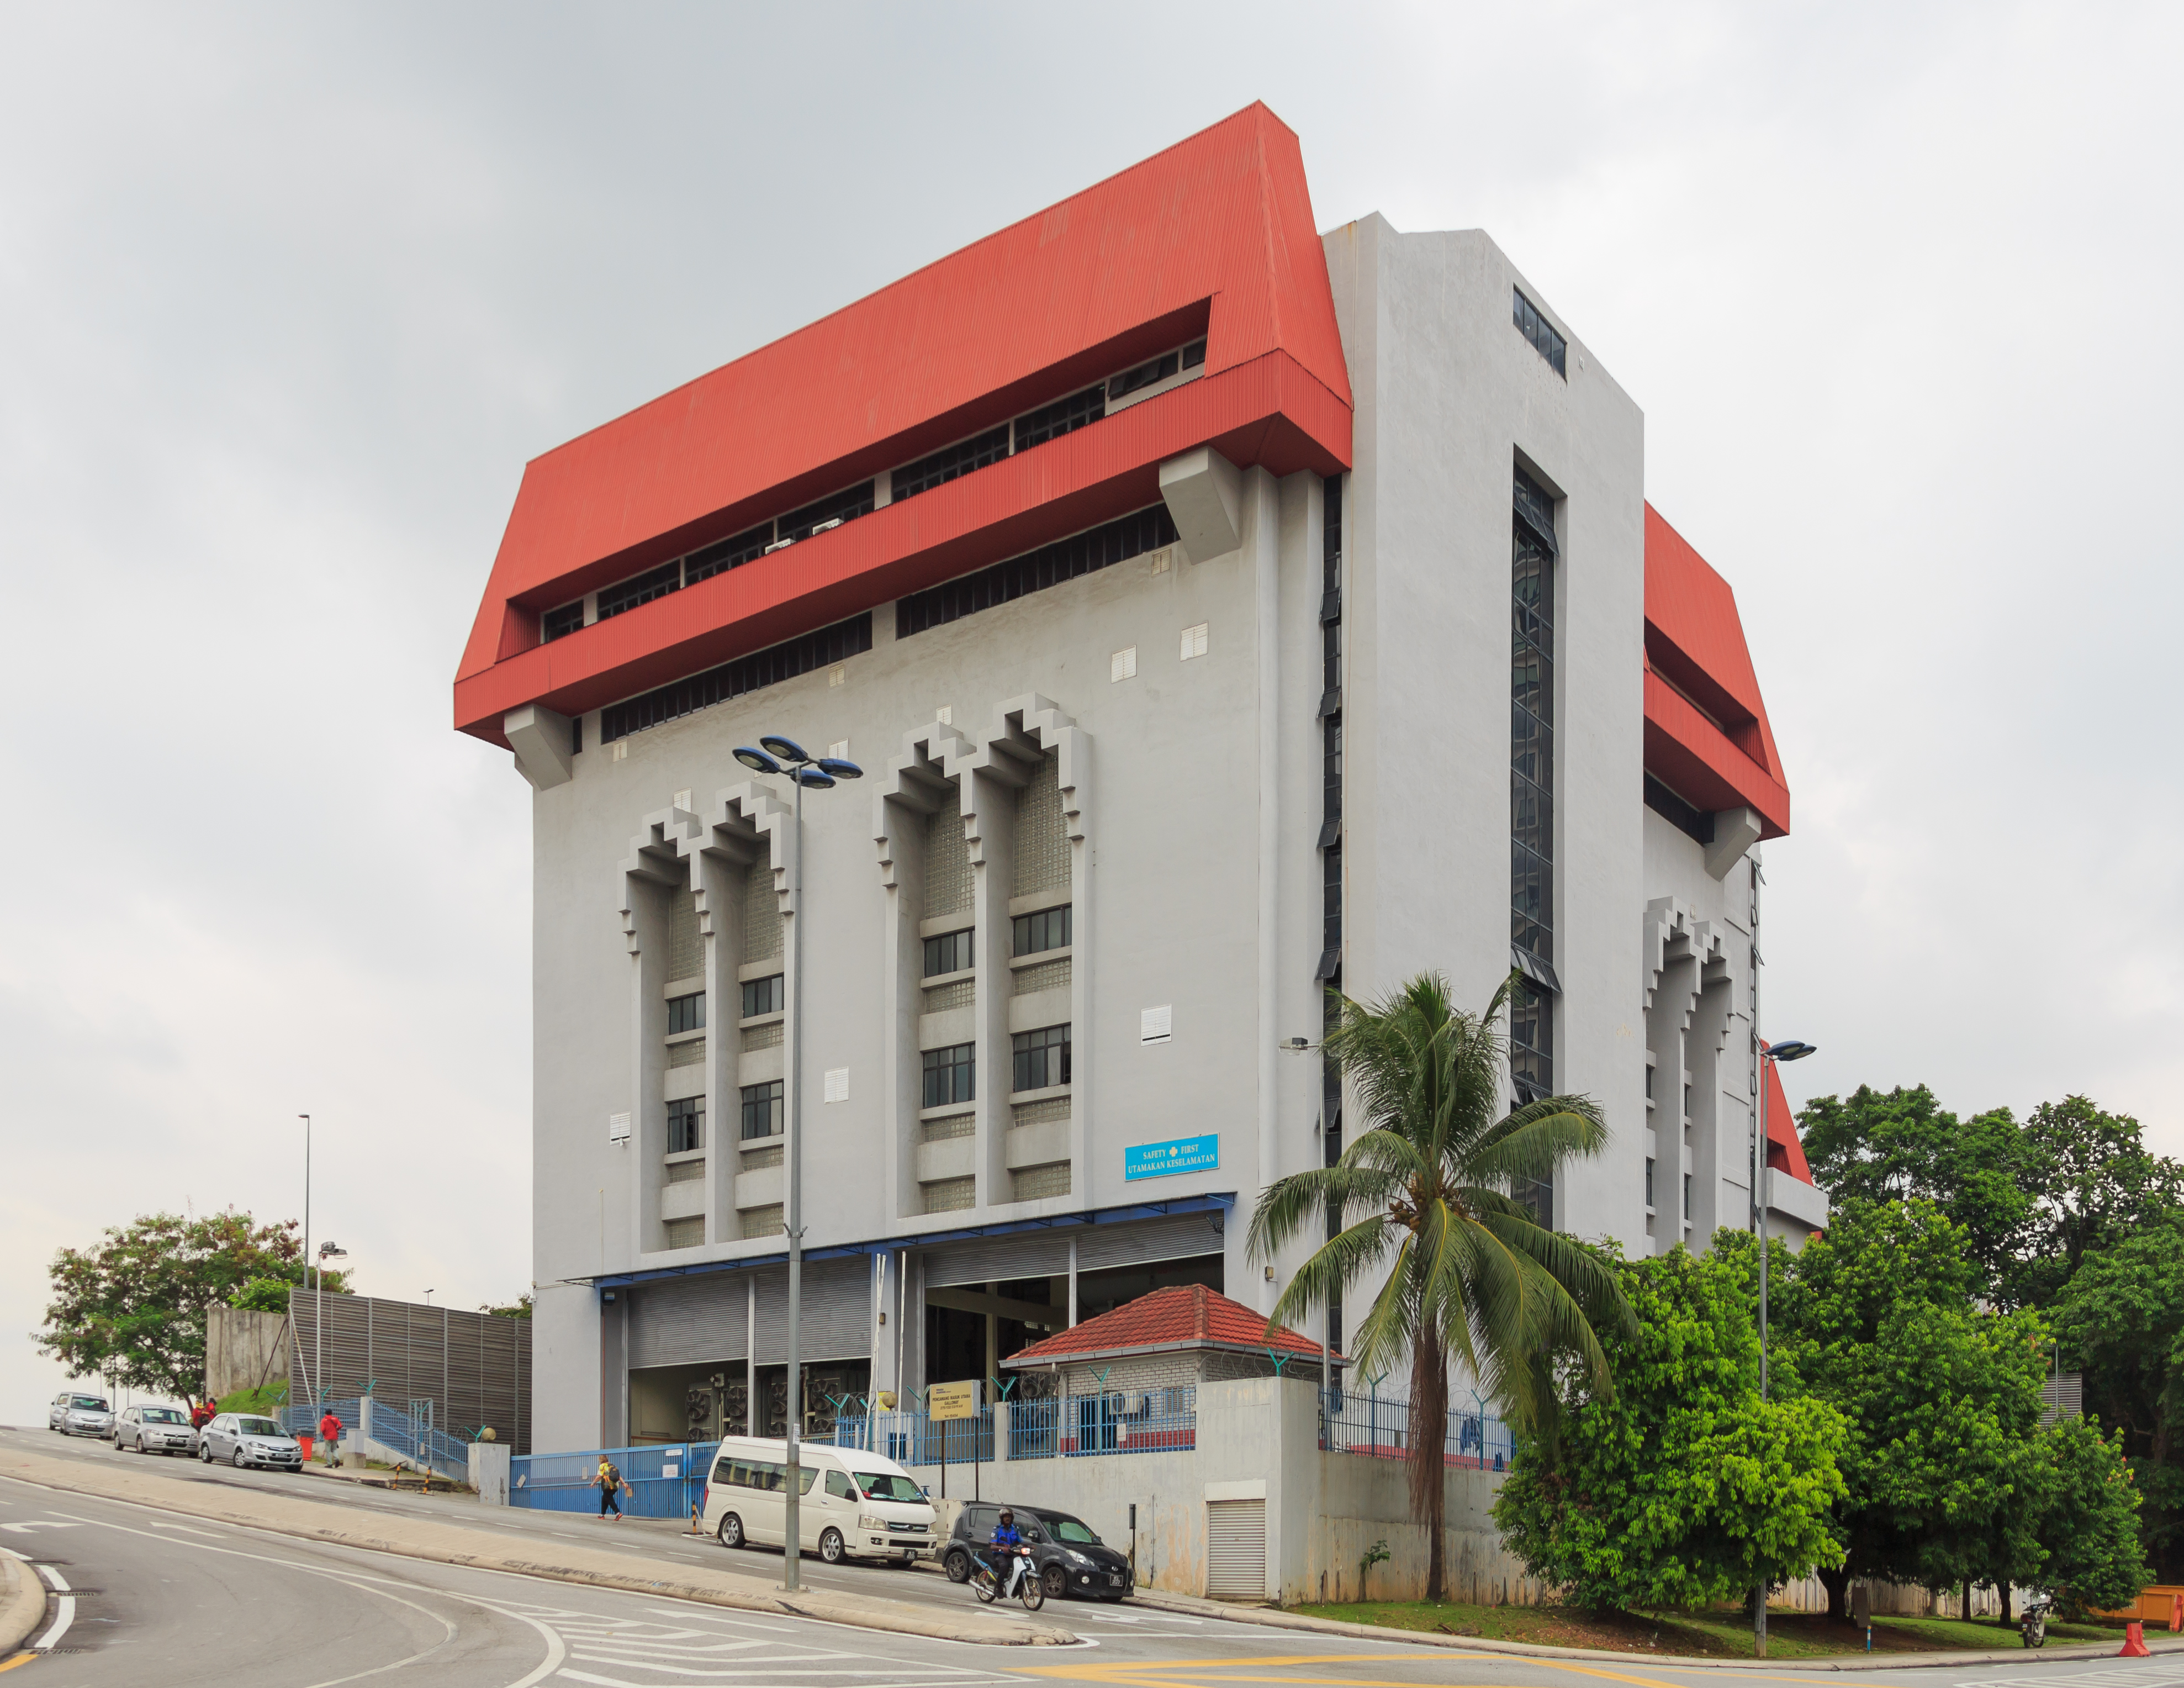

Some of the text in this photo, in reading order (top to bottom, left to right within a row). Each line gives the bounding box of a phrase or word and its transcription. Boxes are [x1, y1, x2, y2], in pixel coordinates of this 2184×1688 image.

[1143, 1144, 1199, 1159] SAFETY FIRST
[1128, 1153, 1215, 1174] UTAMAKAN KESELAMATAN
